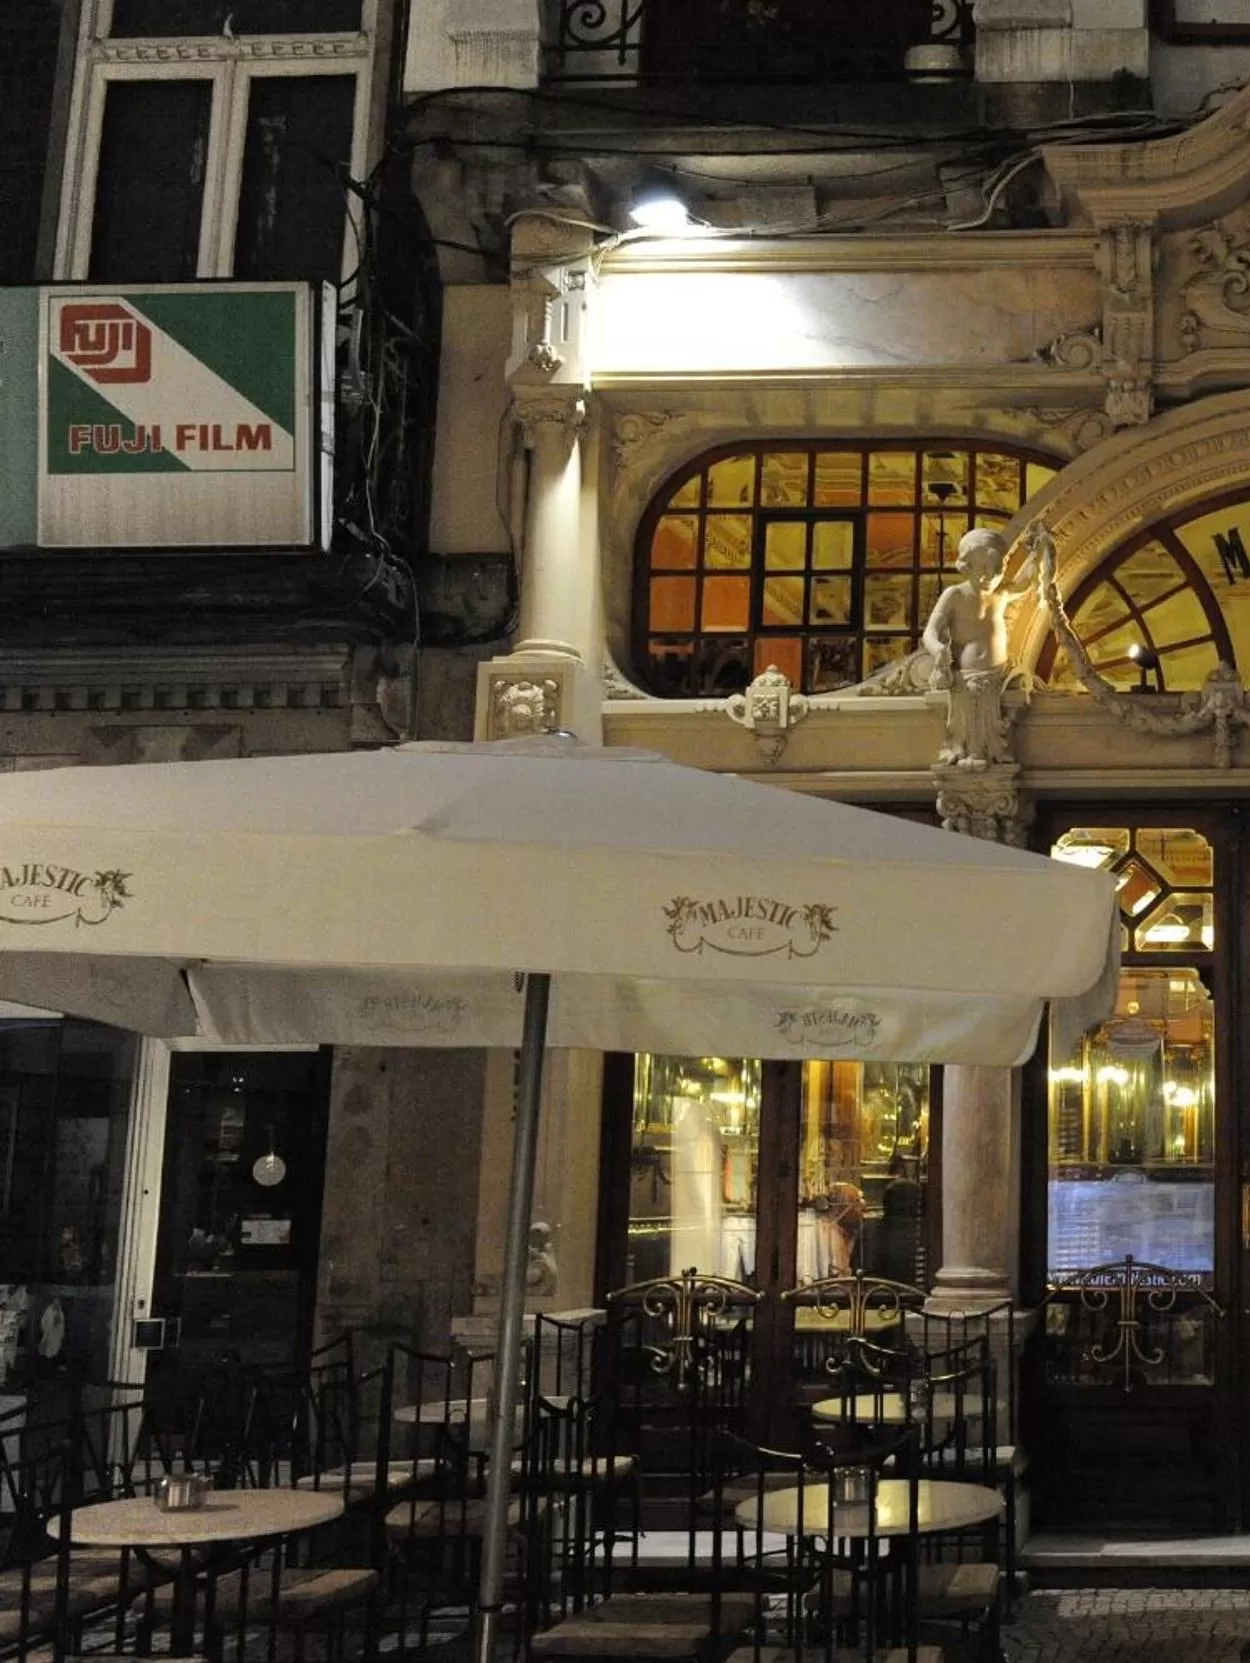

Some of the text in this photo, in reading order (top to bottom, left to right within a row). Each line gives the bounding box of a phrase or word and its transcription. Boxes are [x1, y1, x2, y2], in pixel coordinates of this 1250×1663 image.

[69, 424, 272, 454] FUJI FILM
[0, 863, 94, 897] AJESTIC
[699, 896, 799, 930] MAJESTIC
